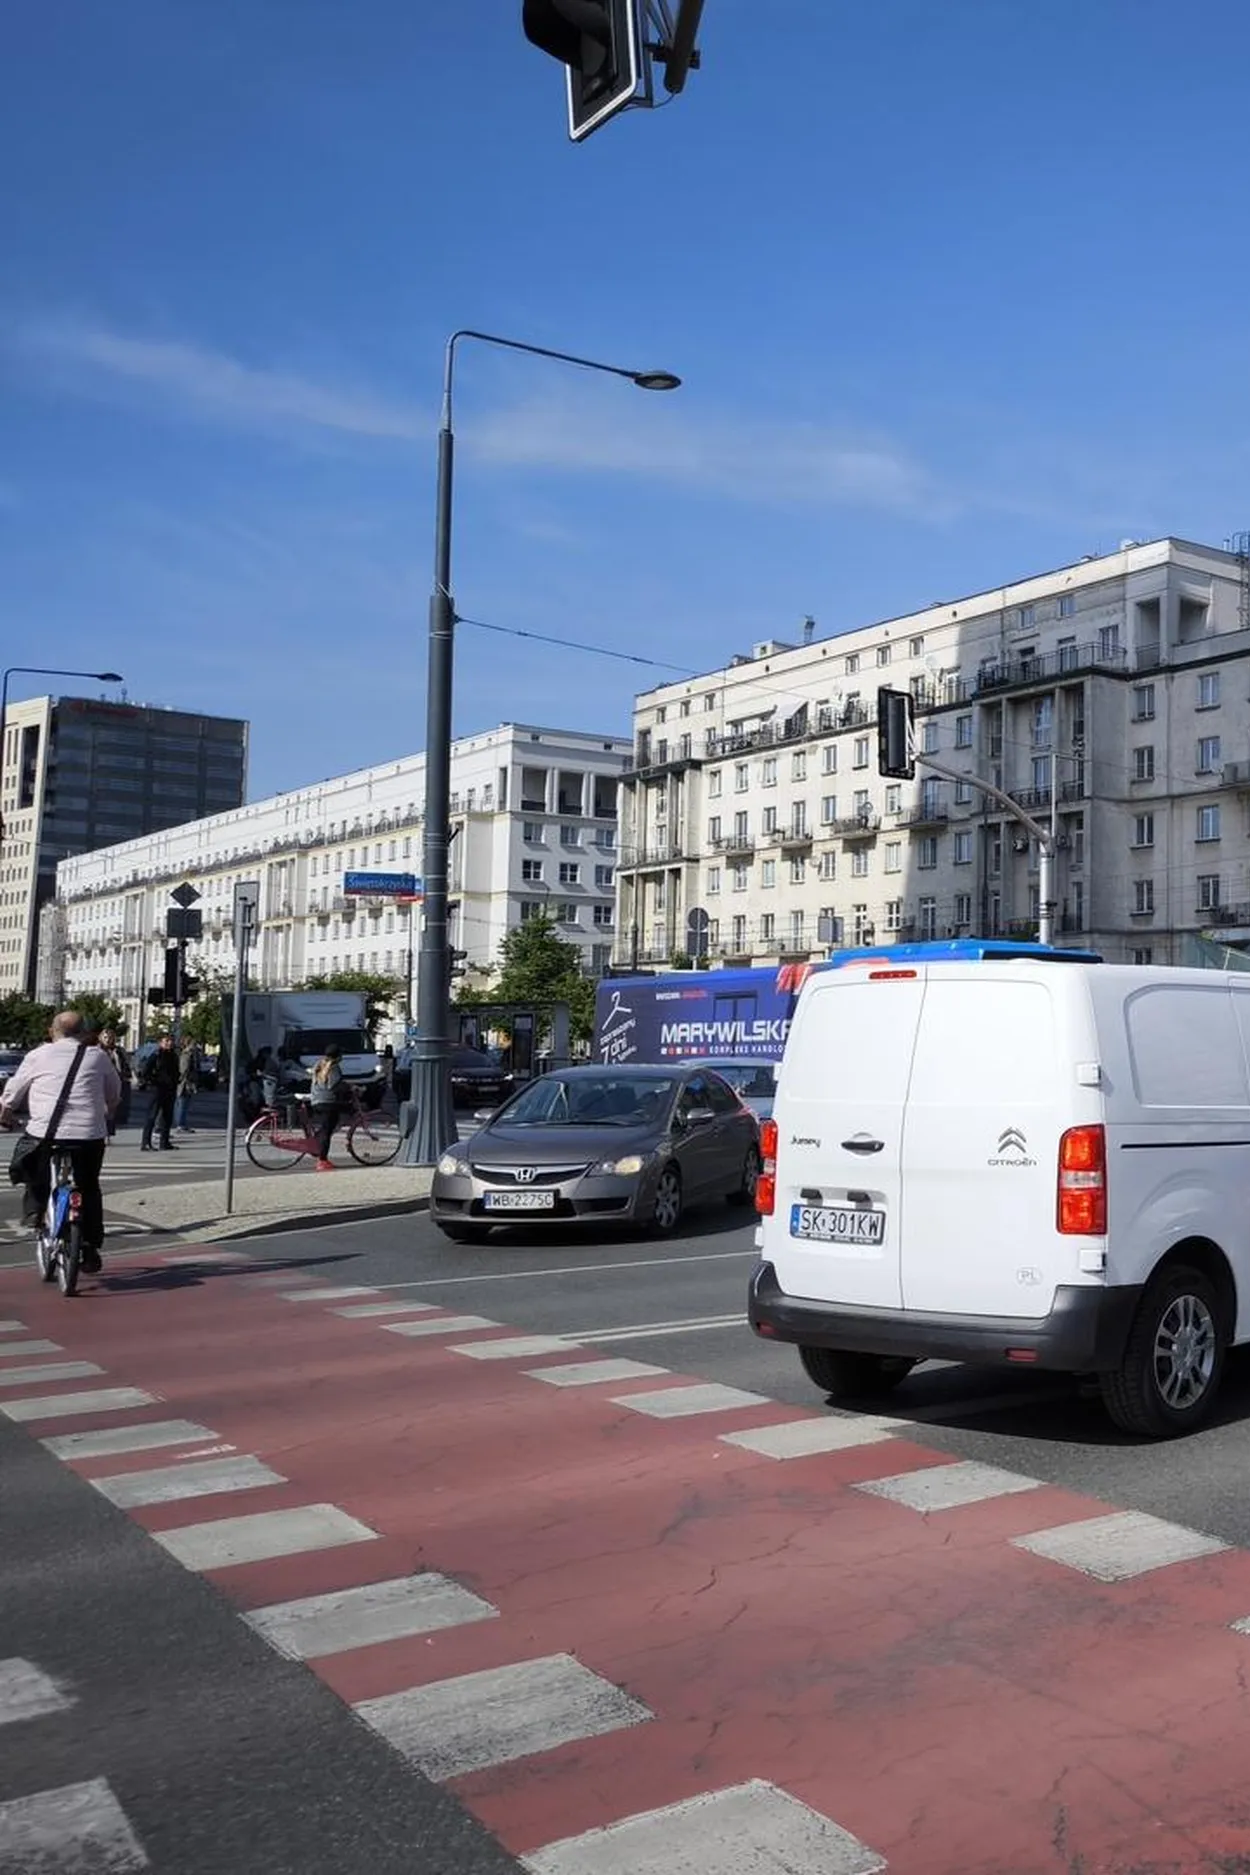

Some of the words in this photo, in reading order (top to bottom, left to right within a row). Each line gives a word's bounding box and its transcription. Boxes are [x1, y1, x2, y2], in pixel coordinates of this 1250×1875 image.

[492, 1194, 511, 1207] WB
[801, 1209, 822, 1231] SK
[828, 1212, 880, 1237] 301KW
